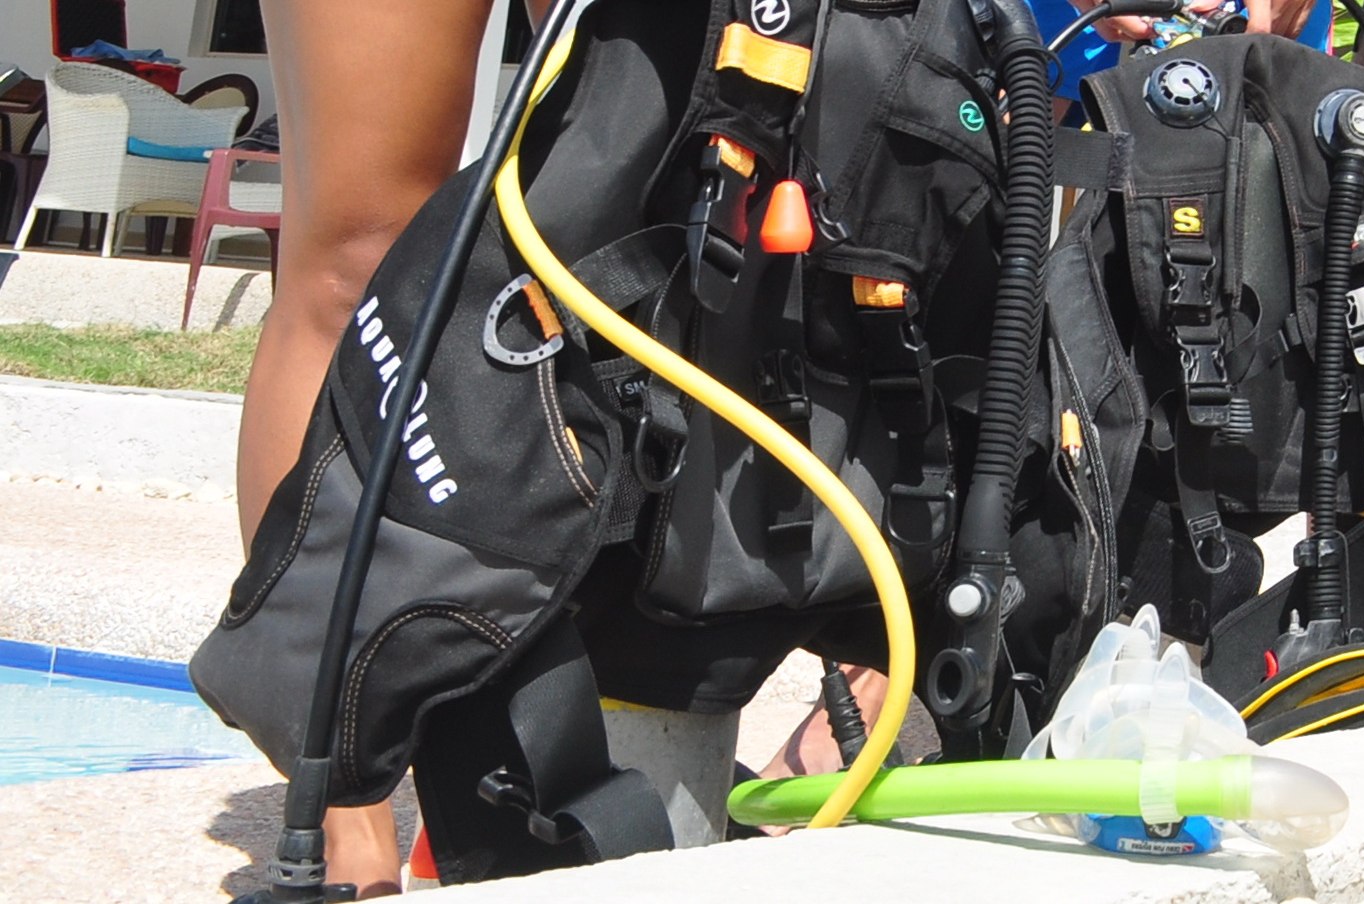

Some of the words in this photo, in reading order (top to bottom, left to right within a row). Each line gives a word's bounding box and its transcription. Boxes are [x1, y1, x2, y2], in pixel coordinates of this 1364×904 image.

[1173, 206, 1201, 233] S
[356, 295, 402, 384] AQUA
[402, 412, 458, 504] LUNG
